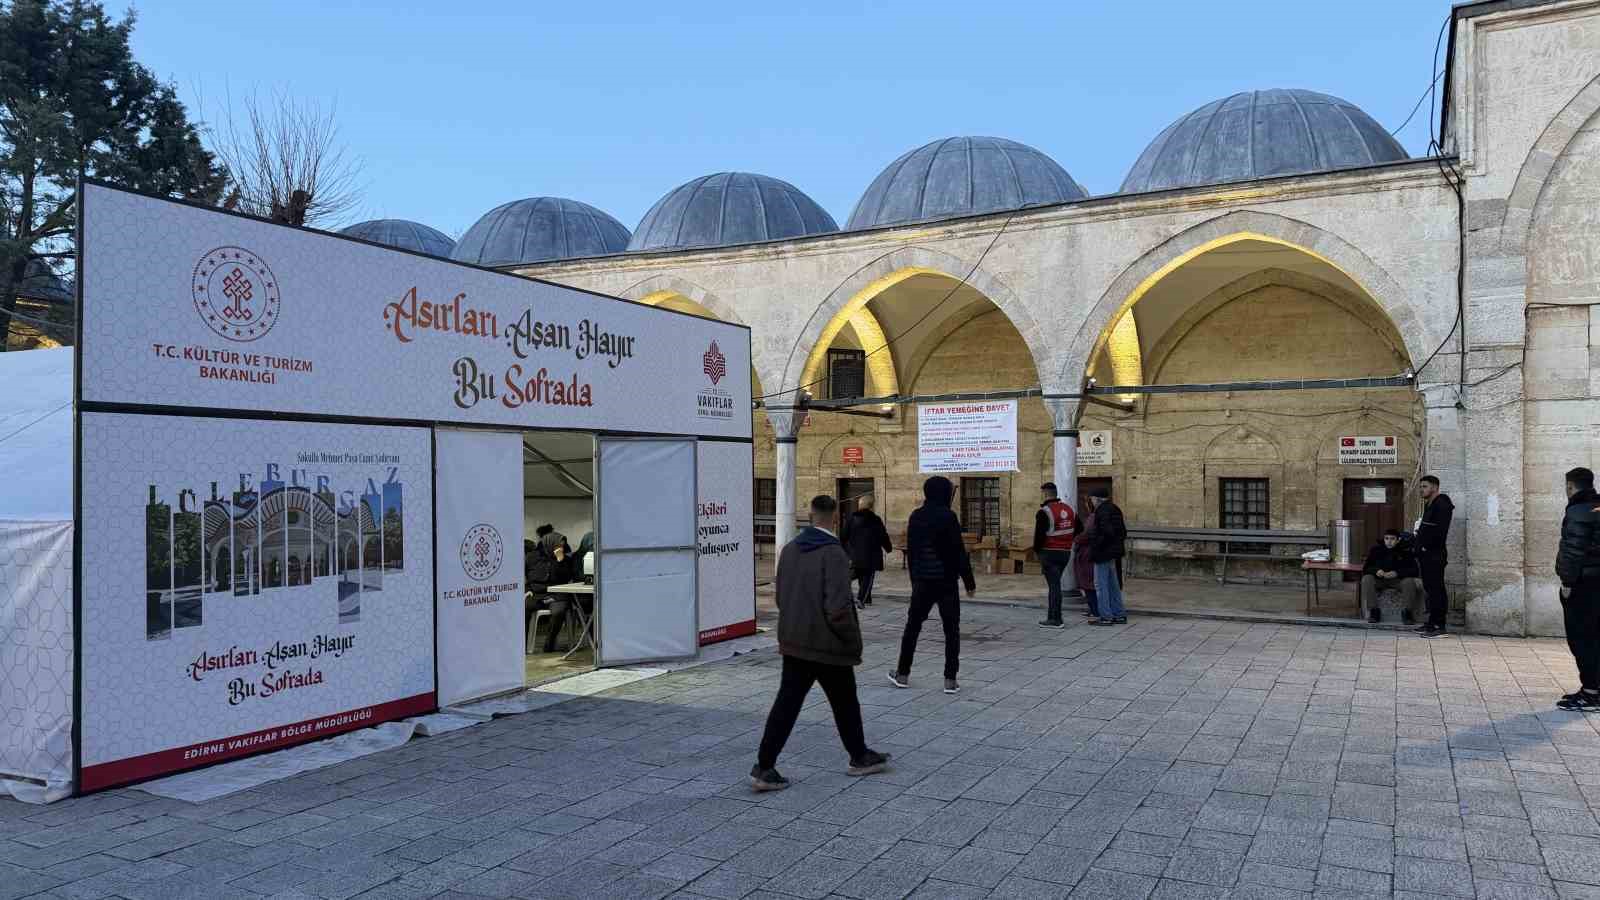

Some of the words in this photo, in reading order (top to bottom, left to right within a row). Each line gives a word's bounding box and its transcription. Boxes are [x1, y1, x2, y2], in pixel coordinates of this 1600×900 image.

[383, 286, 499, 343] Asırları
[503, 308, 571, 359] Aşan
[575, 318, 637, 369] Hayır
[153, 343, 179, 359] T.C.
[184, 345, 240, 366] KÜLTÜR
[243, 353, 261, 368] VE
[264, 354, 313, 373] TURİZM
[199, 365, 276, 386] BAKANLIĞI
[452, 356, 497, 409] Bu
[501, 363, 593, 409] Sofrada
[697, 394, 733, 409] VAKIFLAR
[986, 403, 1010, 412] DAVET
[484, 584, 493, 594] VE
[186, 644, 258, 681] Asırları
[261, 640, 308, 670] Aşan
[310, 633, 356, 659] Hayır
[227, 677, 256, 706] Bu
[259, 666, 324, 699] Sofrada
[183, 742, 225, 761] EDİRNE
[227, 730, 278, 753] VAKIFLAR
[280, 721, 313, 739] BÖLGE
[315, 708, 373, 731] MÜDÜRLÜĞÜ
